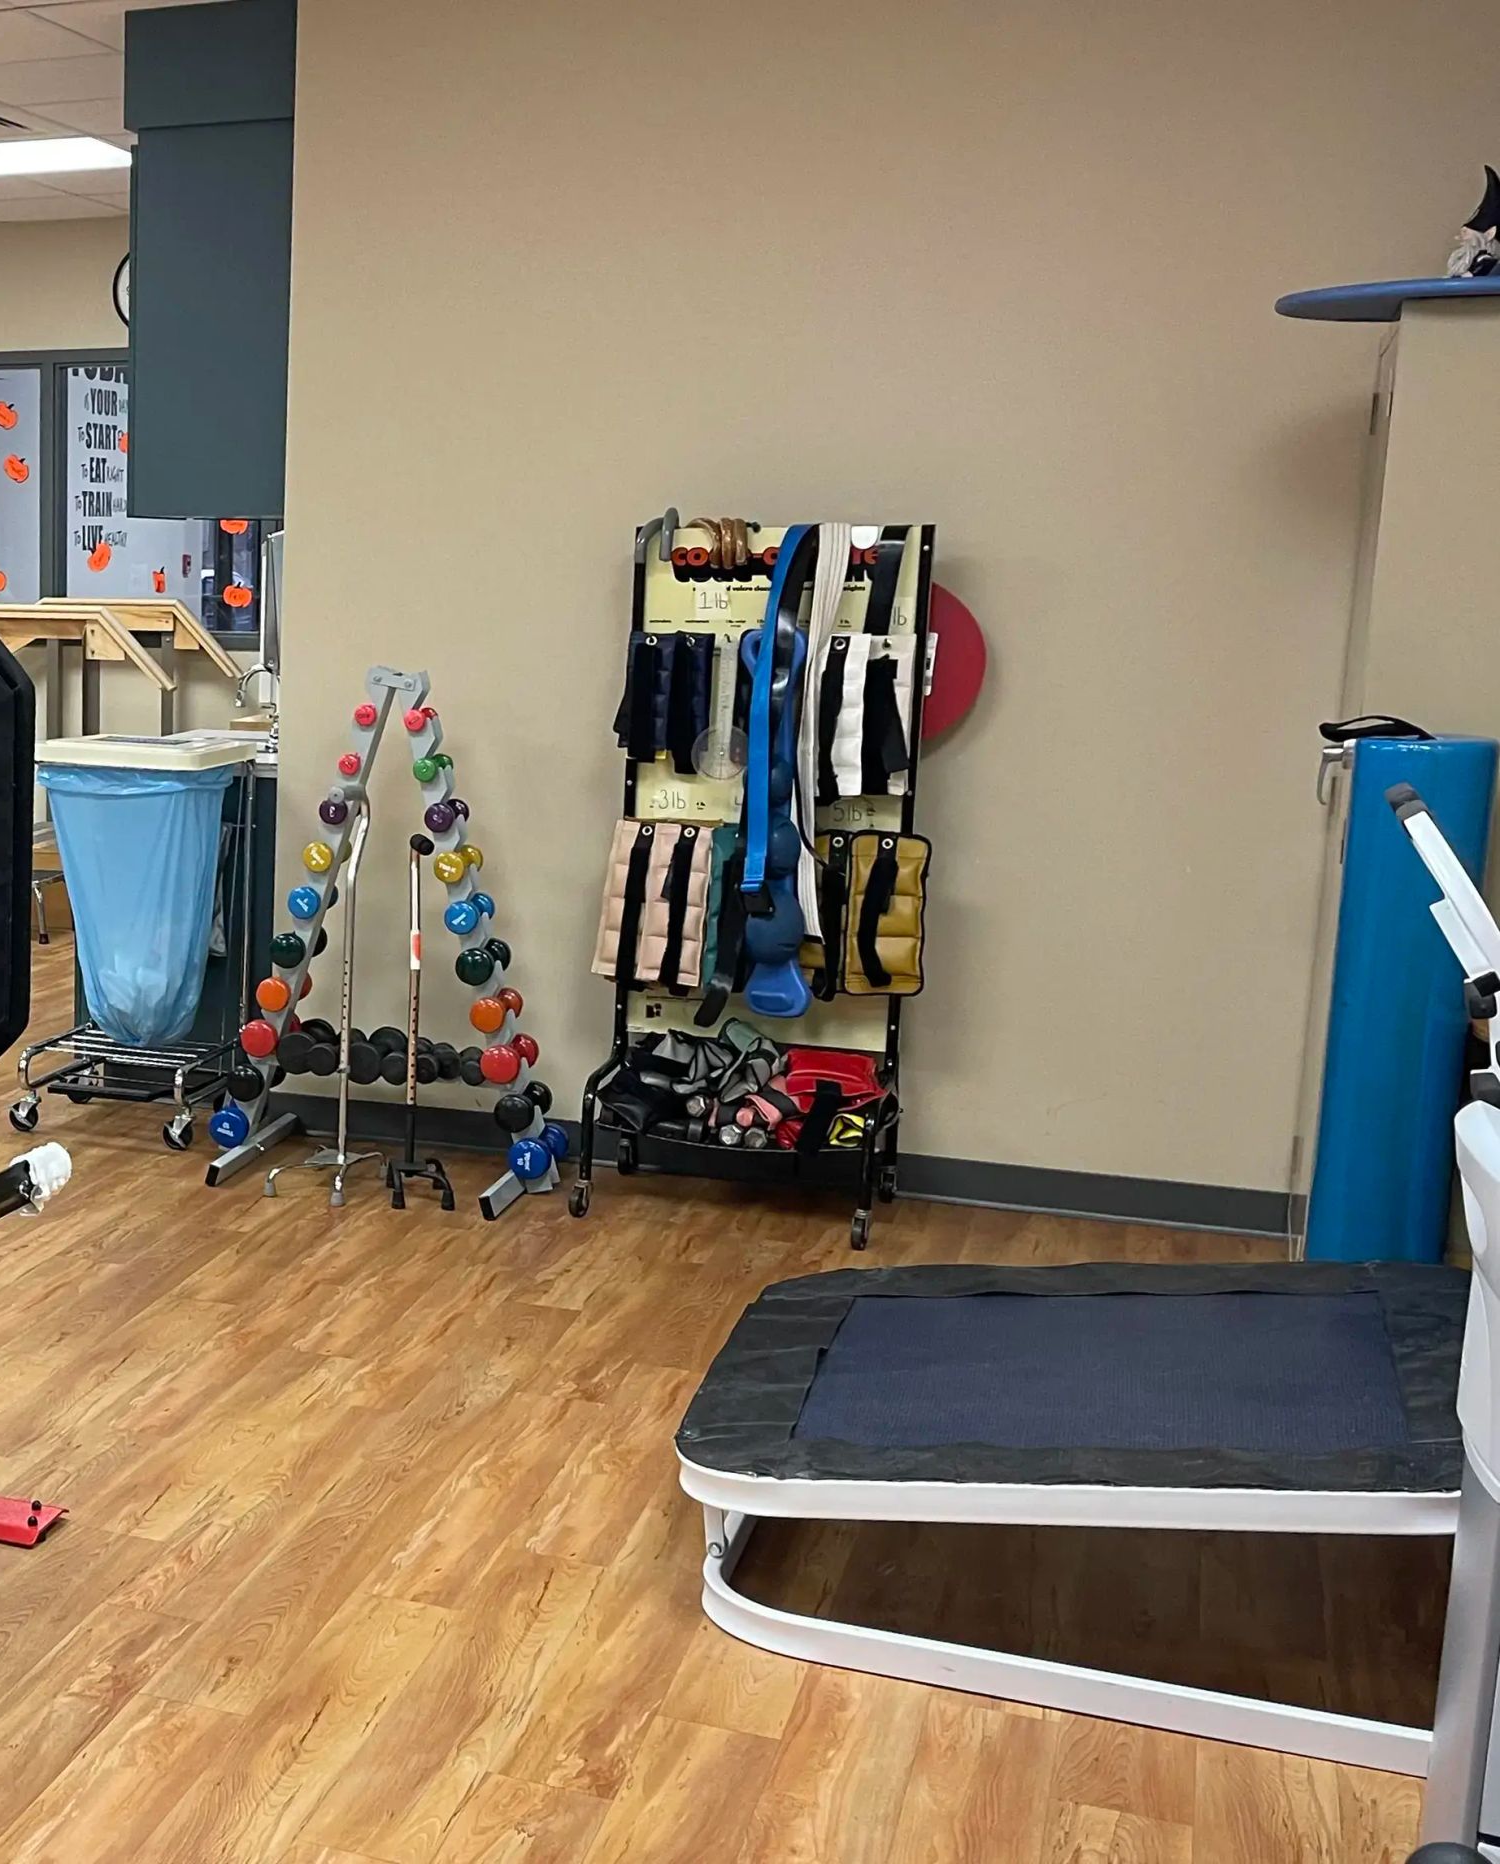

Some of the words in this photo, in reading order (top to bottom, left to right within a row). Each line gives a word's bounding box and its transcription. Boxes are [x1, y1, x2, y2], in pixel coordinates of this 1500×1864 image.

[90, 387, 118, 416] YOUR
[86, 422, 117, 450] START
[89, 457, 107, 483] EAT
[82, 491, 112, 517] TRAIN
